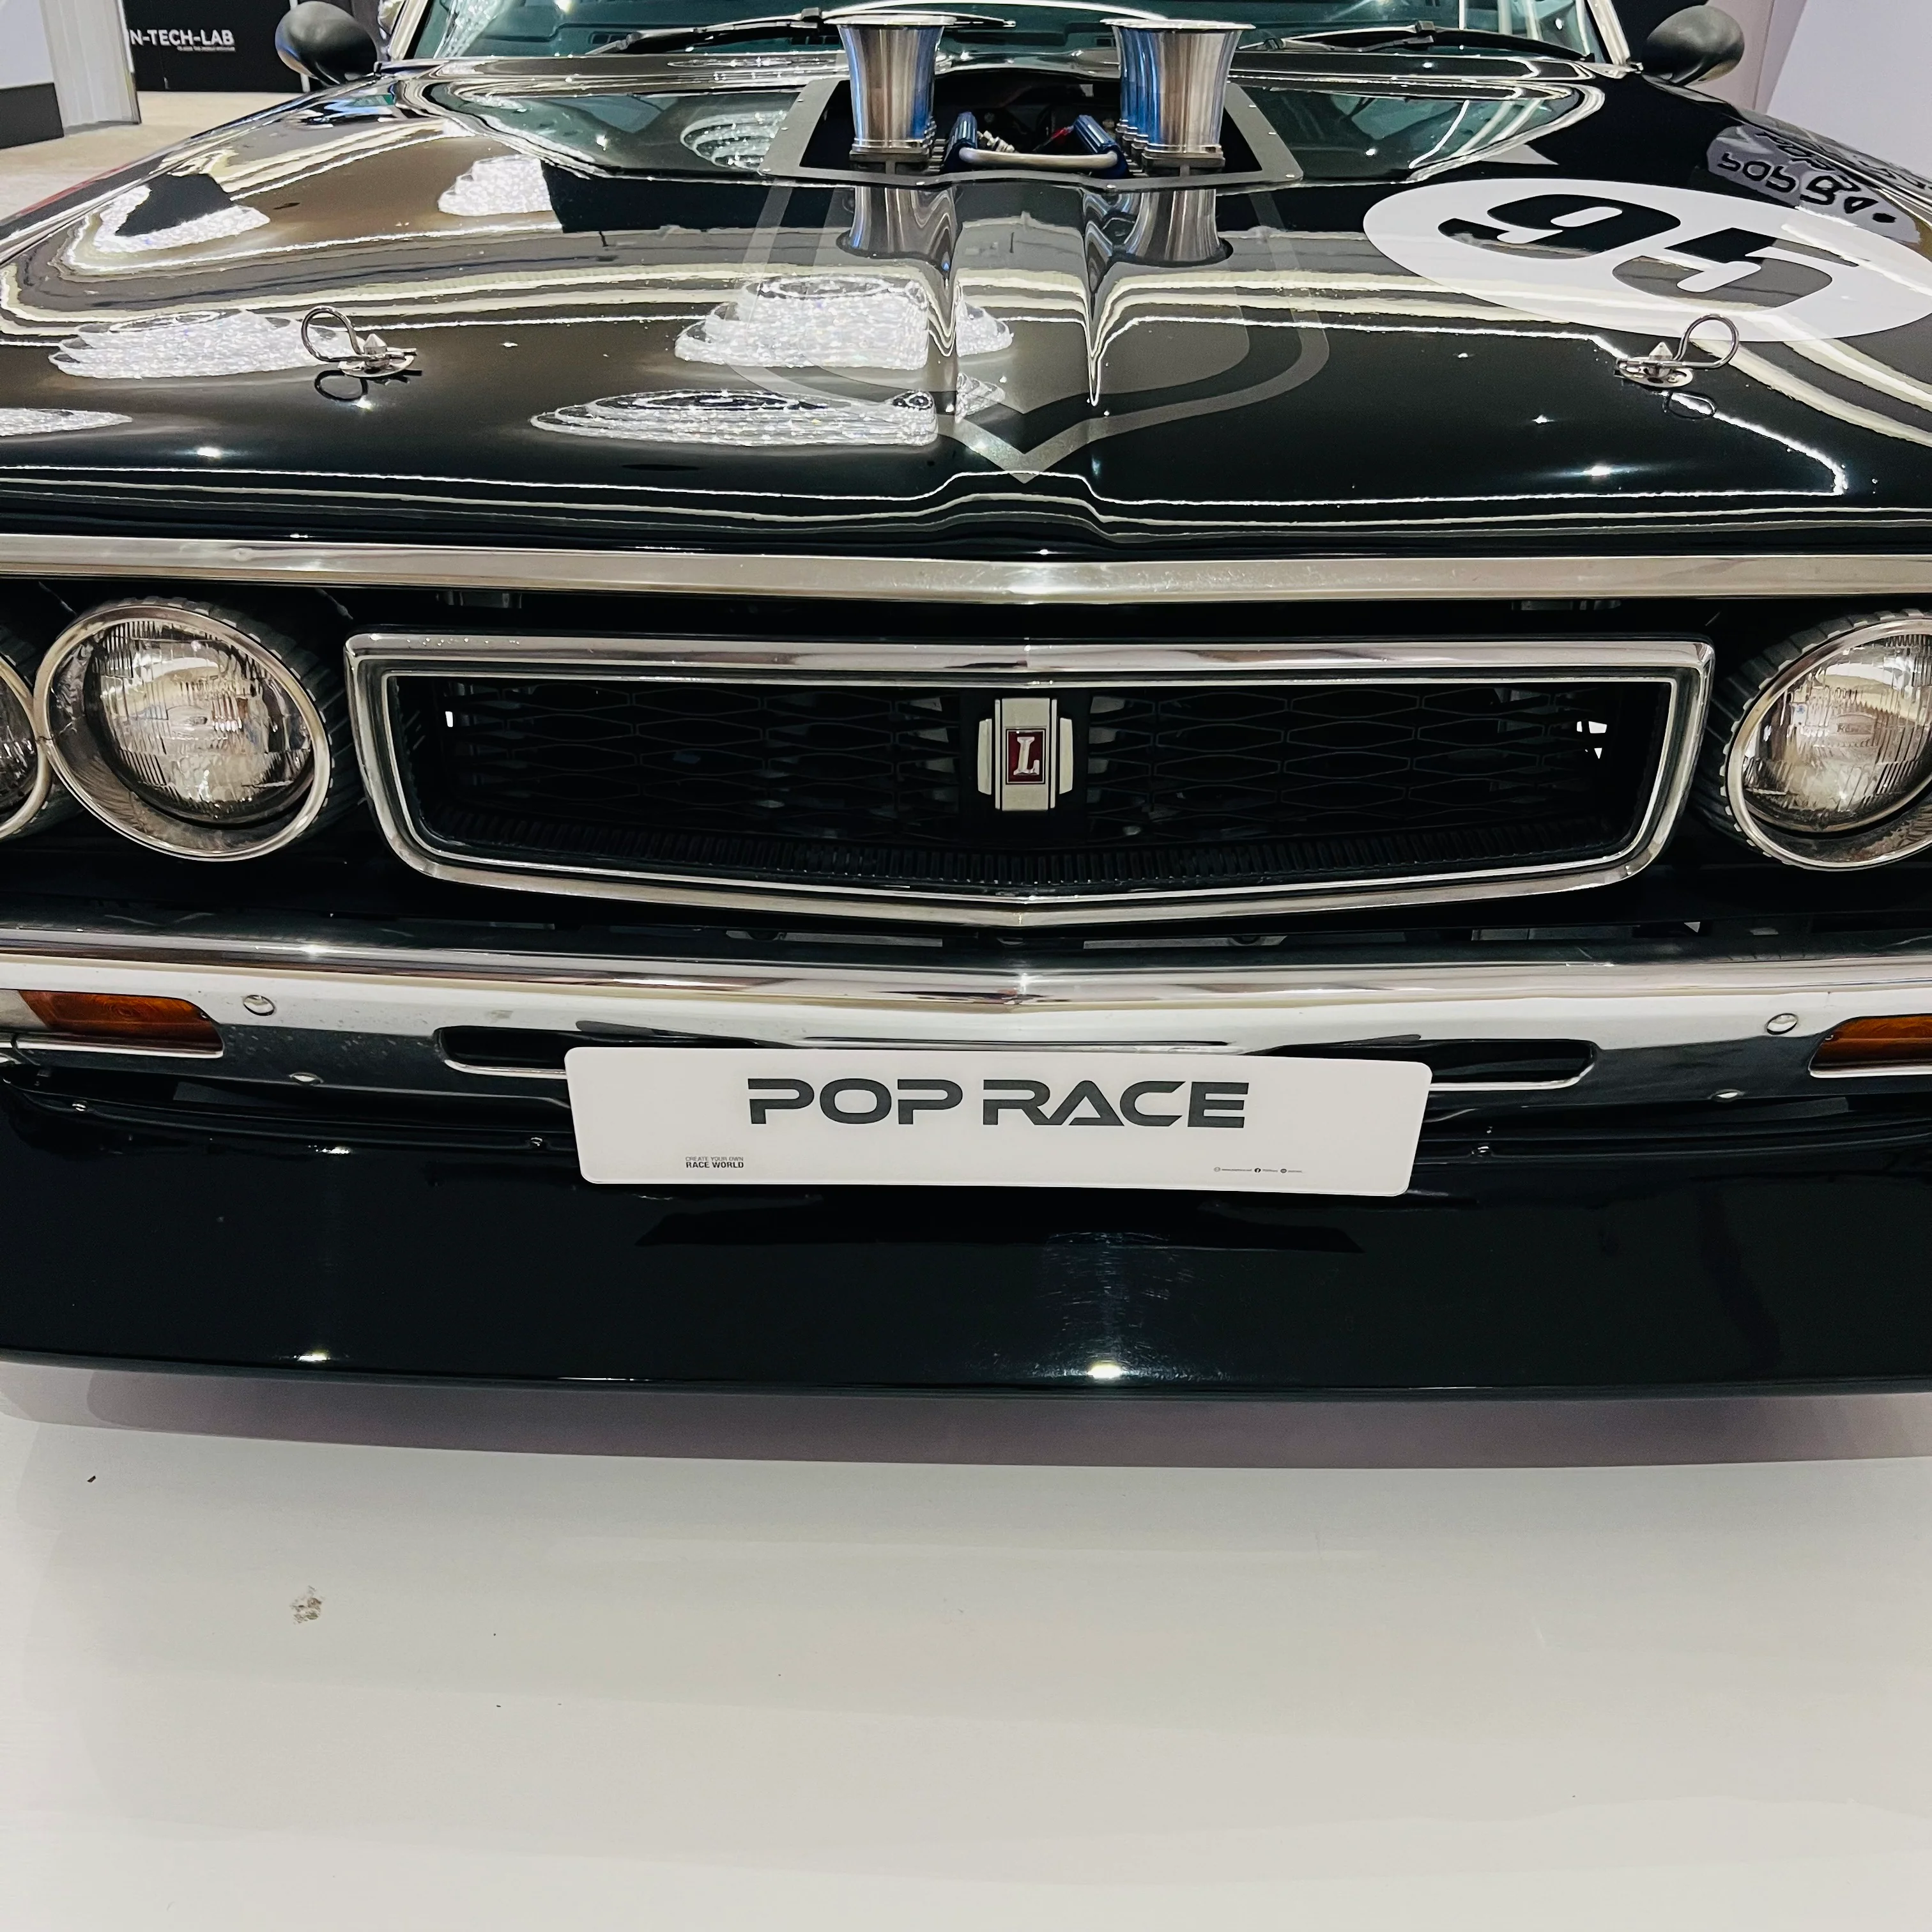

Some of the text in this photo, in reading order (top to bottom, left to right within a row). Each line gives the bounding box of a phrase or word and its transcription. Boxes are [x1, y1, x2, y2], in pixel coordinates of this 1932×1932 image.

[1438, 194, 1859, 309] 95
[1013, 736, 1040, 776] L
[747, 1078, 1250, 1128] POP RACE
